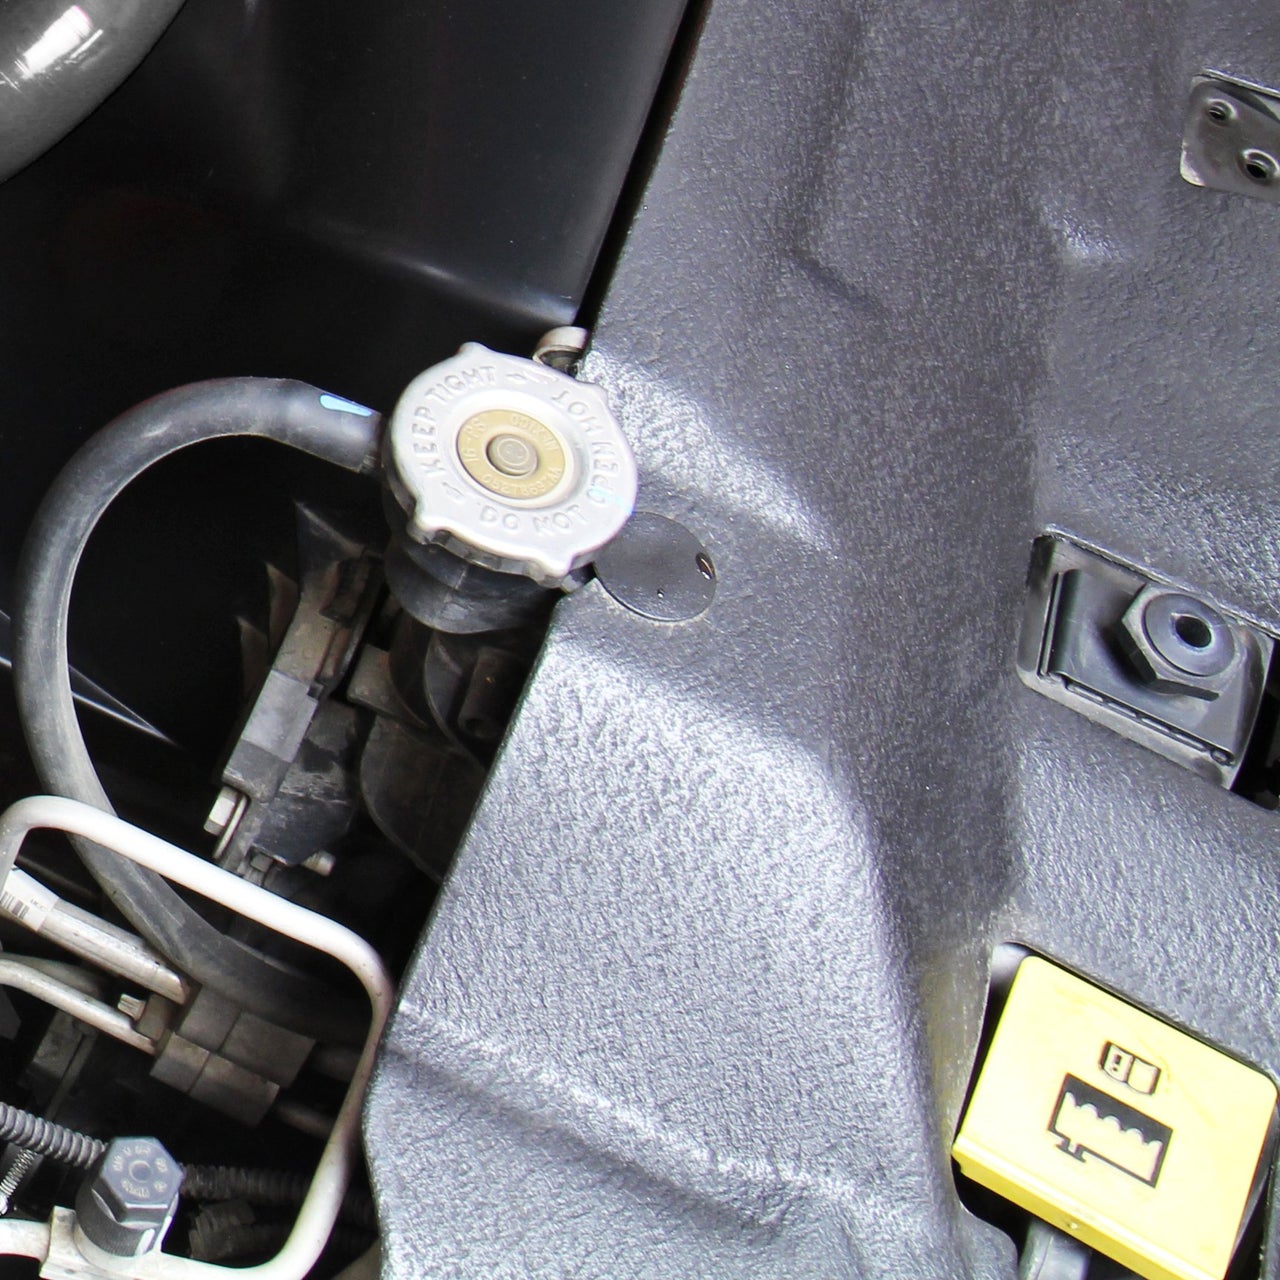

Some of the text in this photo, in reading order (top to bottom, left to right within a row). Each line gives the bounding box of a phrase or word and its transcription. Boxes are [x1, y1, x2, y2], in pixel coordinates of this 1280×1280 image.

[411, 365, 496, 477] KEEP TIGHT
[480, 389, 619, 537] DO NOT OPEN HOT
